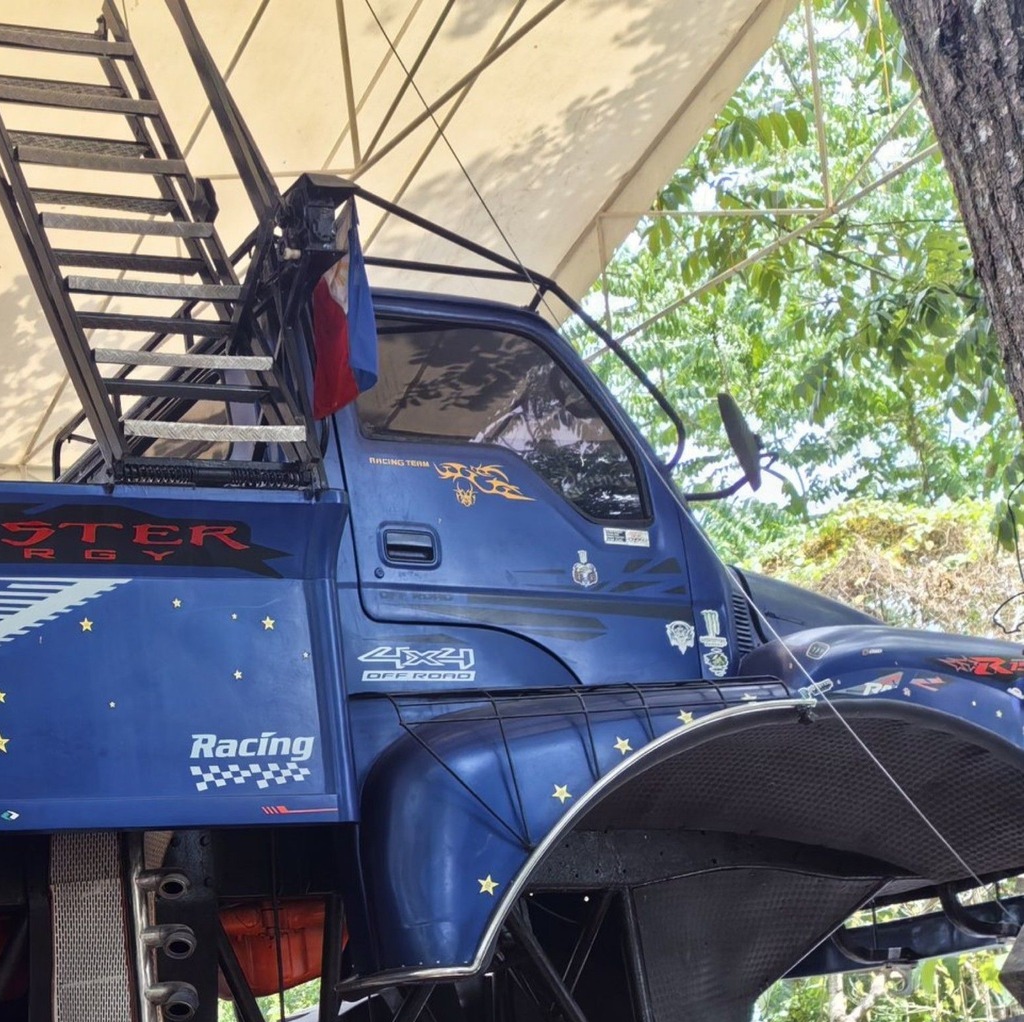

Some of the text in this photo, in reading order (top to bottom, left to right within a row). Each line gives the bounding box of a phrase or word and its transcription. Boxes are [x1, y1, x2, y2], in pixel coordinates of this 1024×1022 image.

[369, 457, 429, 468] RACING TEAM
[366, 672, 471, 680] OFF ROAD
[189, 732, 315, 761] Racing
